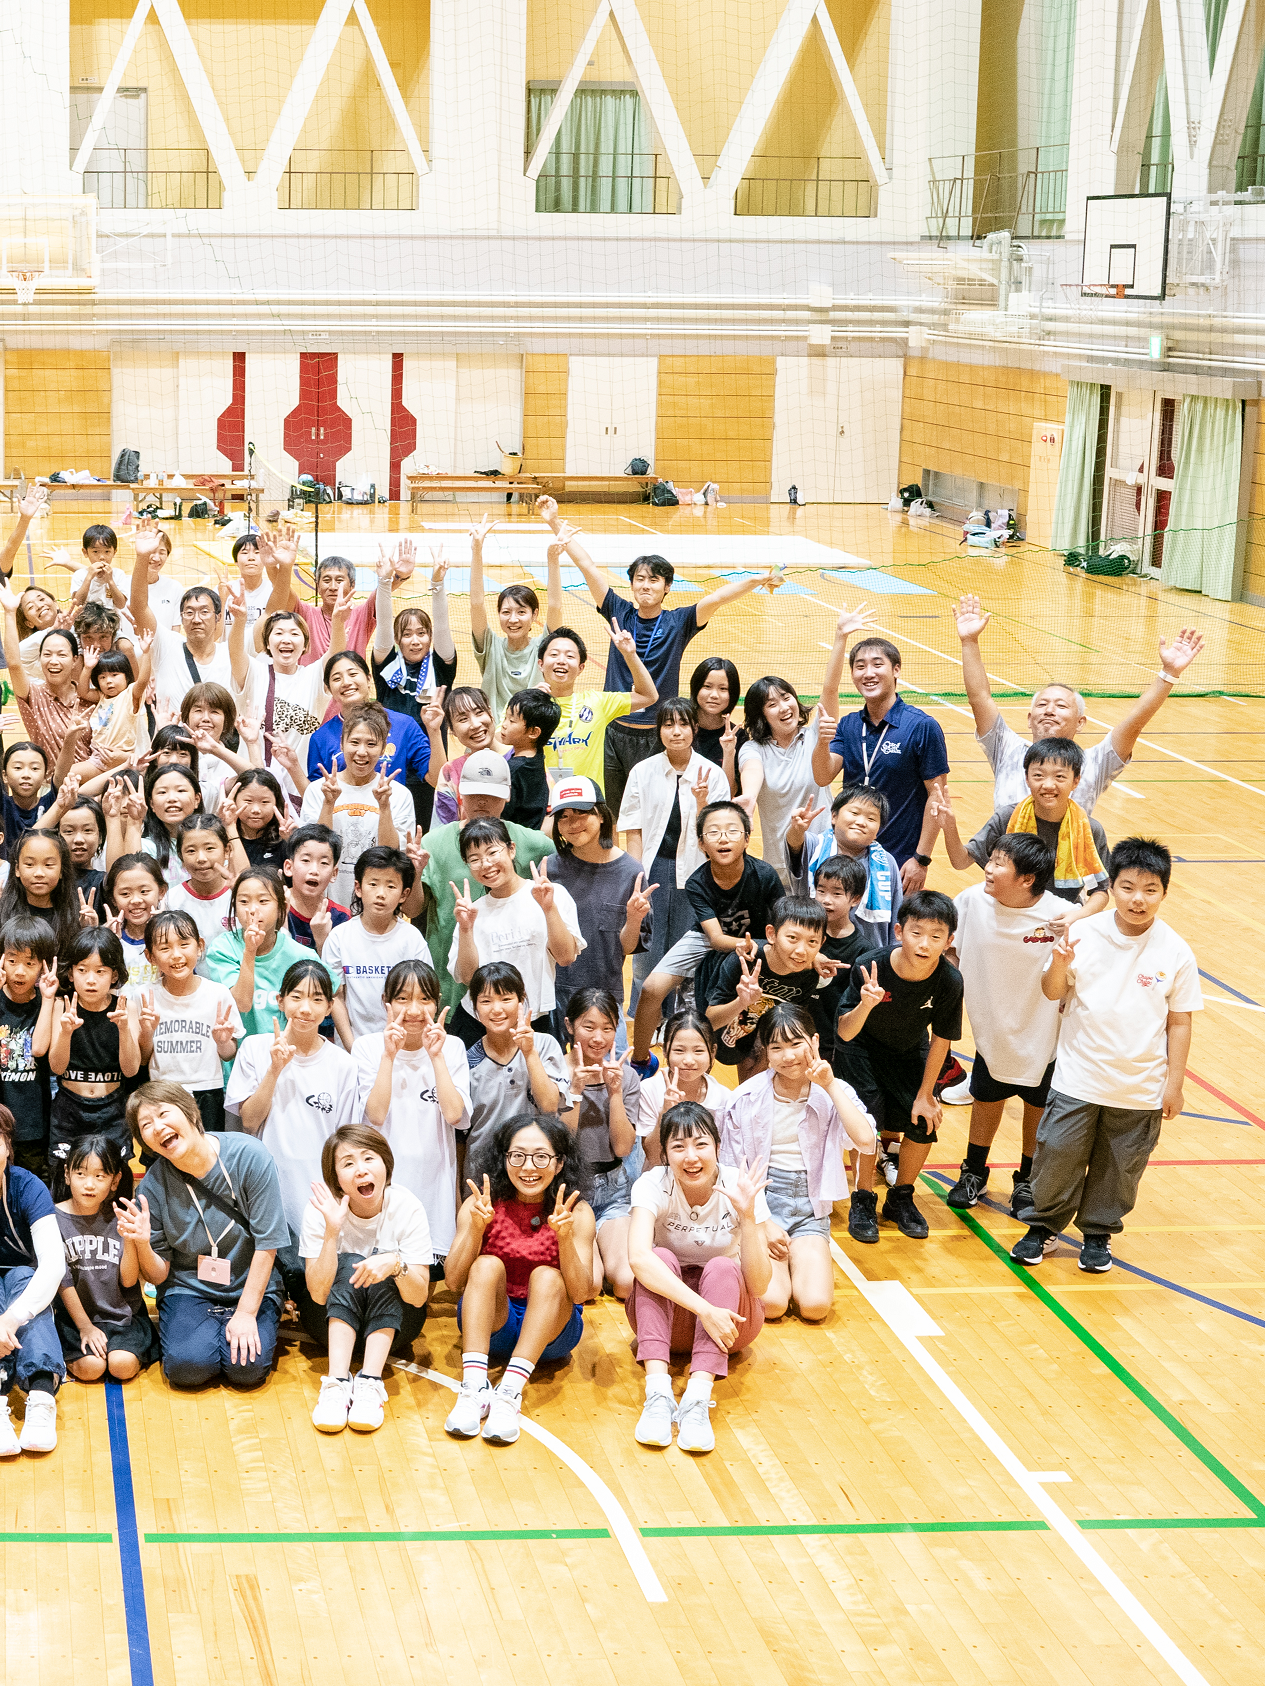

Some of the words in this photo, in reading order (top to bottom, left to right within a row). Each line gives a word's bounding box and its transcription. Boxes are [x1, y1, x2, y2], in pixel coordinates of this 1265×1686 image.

[877, 871, 892, 901] CUP
[356, 965, 394, 975] BASKET
[155, 1019, 211, 1039] EMORABLE
[156, 1040, 202, 1054] SUMMER
[62, 1070, 84, 1081] OVE
[667, 1220, 732, 1234] PERPETUAL
[64, 1234, 121, 1265] IPPLE
